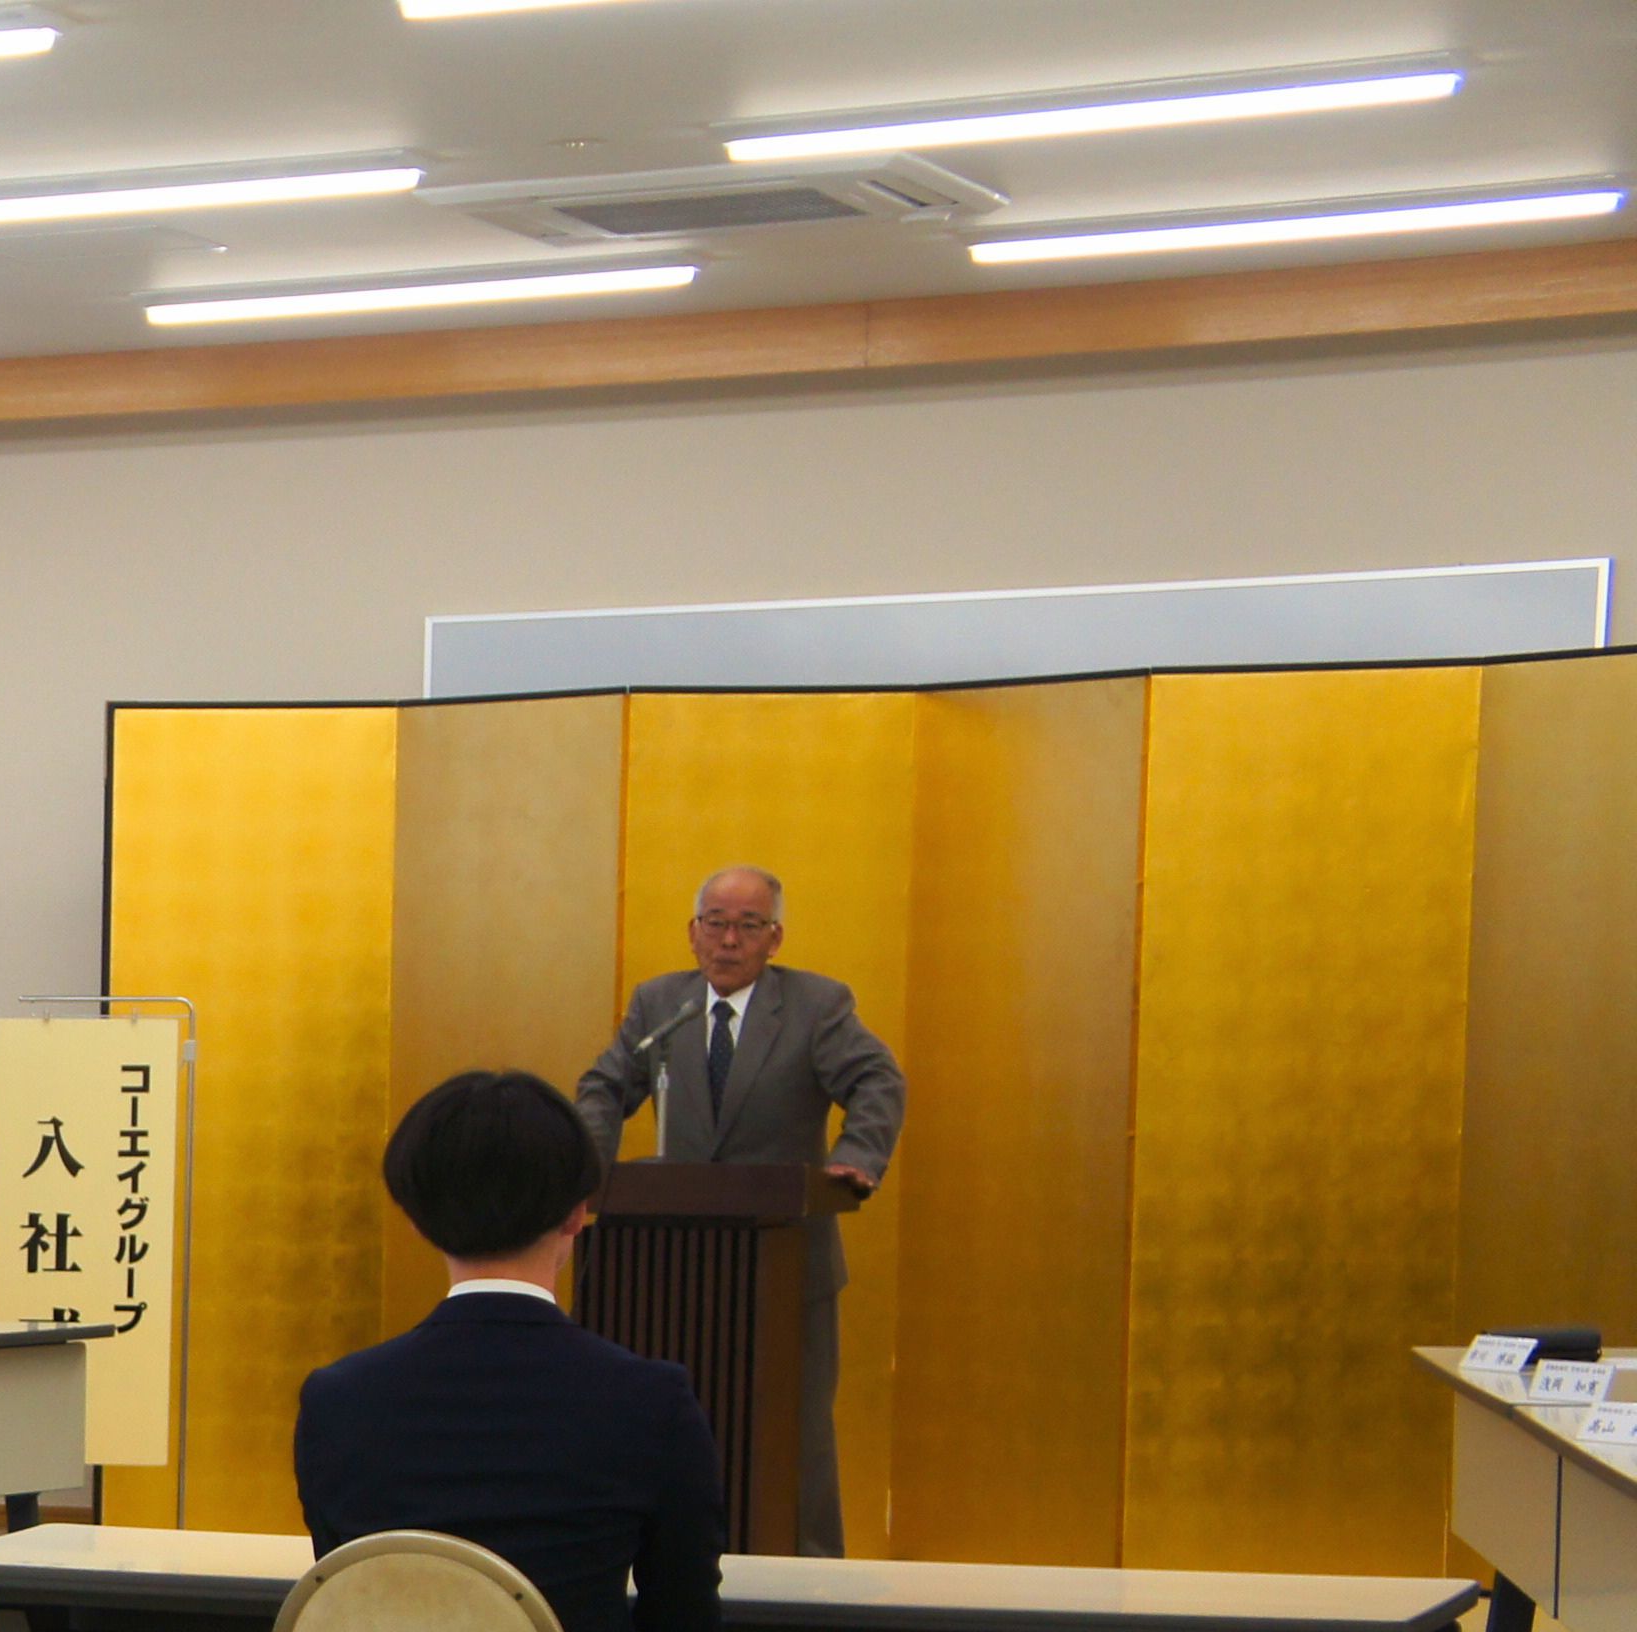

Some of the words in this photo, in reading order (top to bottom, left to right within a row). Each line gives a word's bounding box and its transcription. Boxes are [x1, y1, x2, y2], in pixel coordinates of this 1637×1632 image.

[113, 1064, 151, 1335] コーエイグループ
